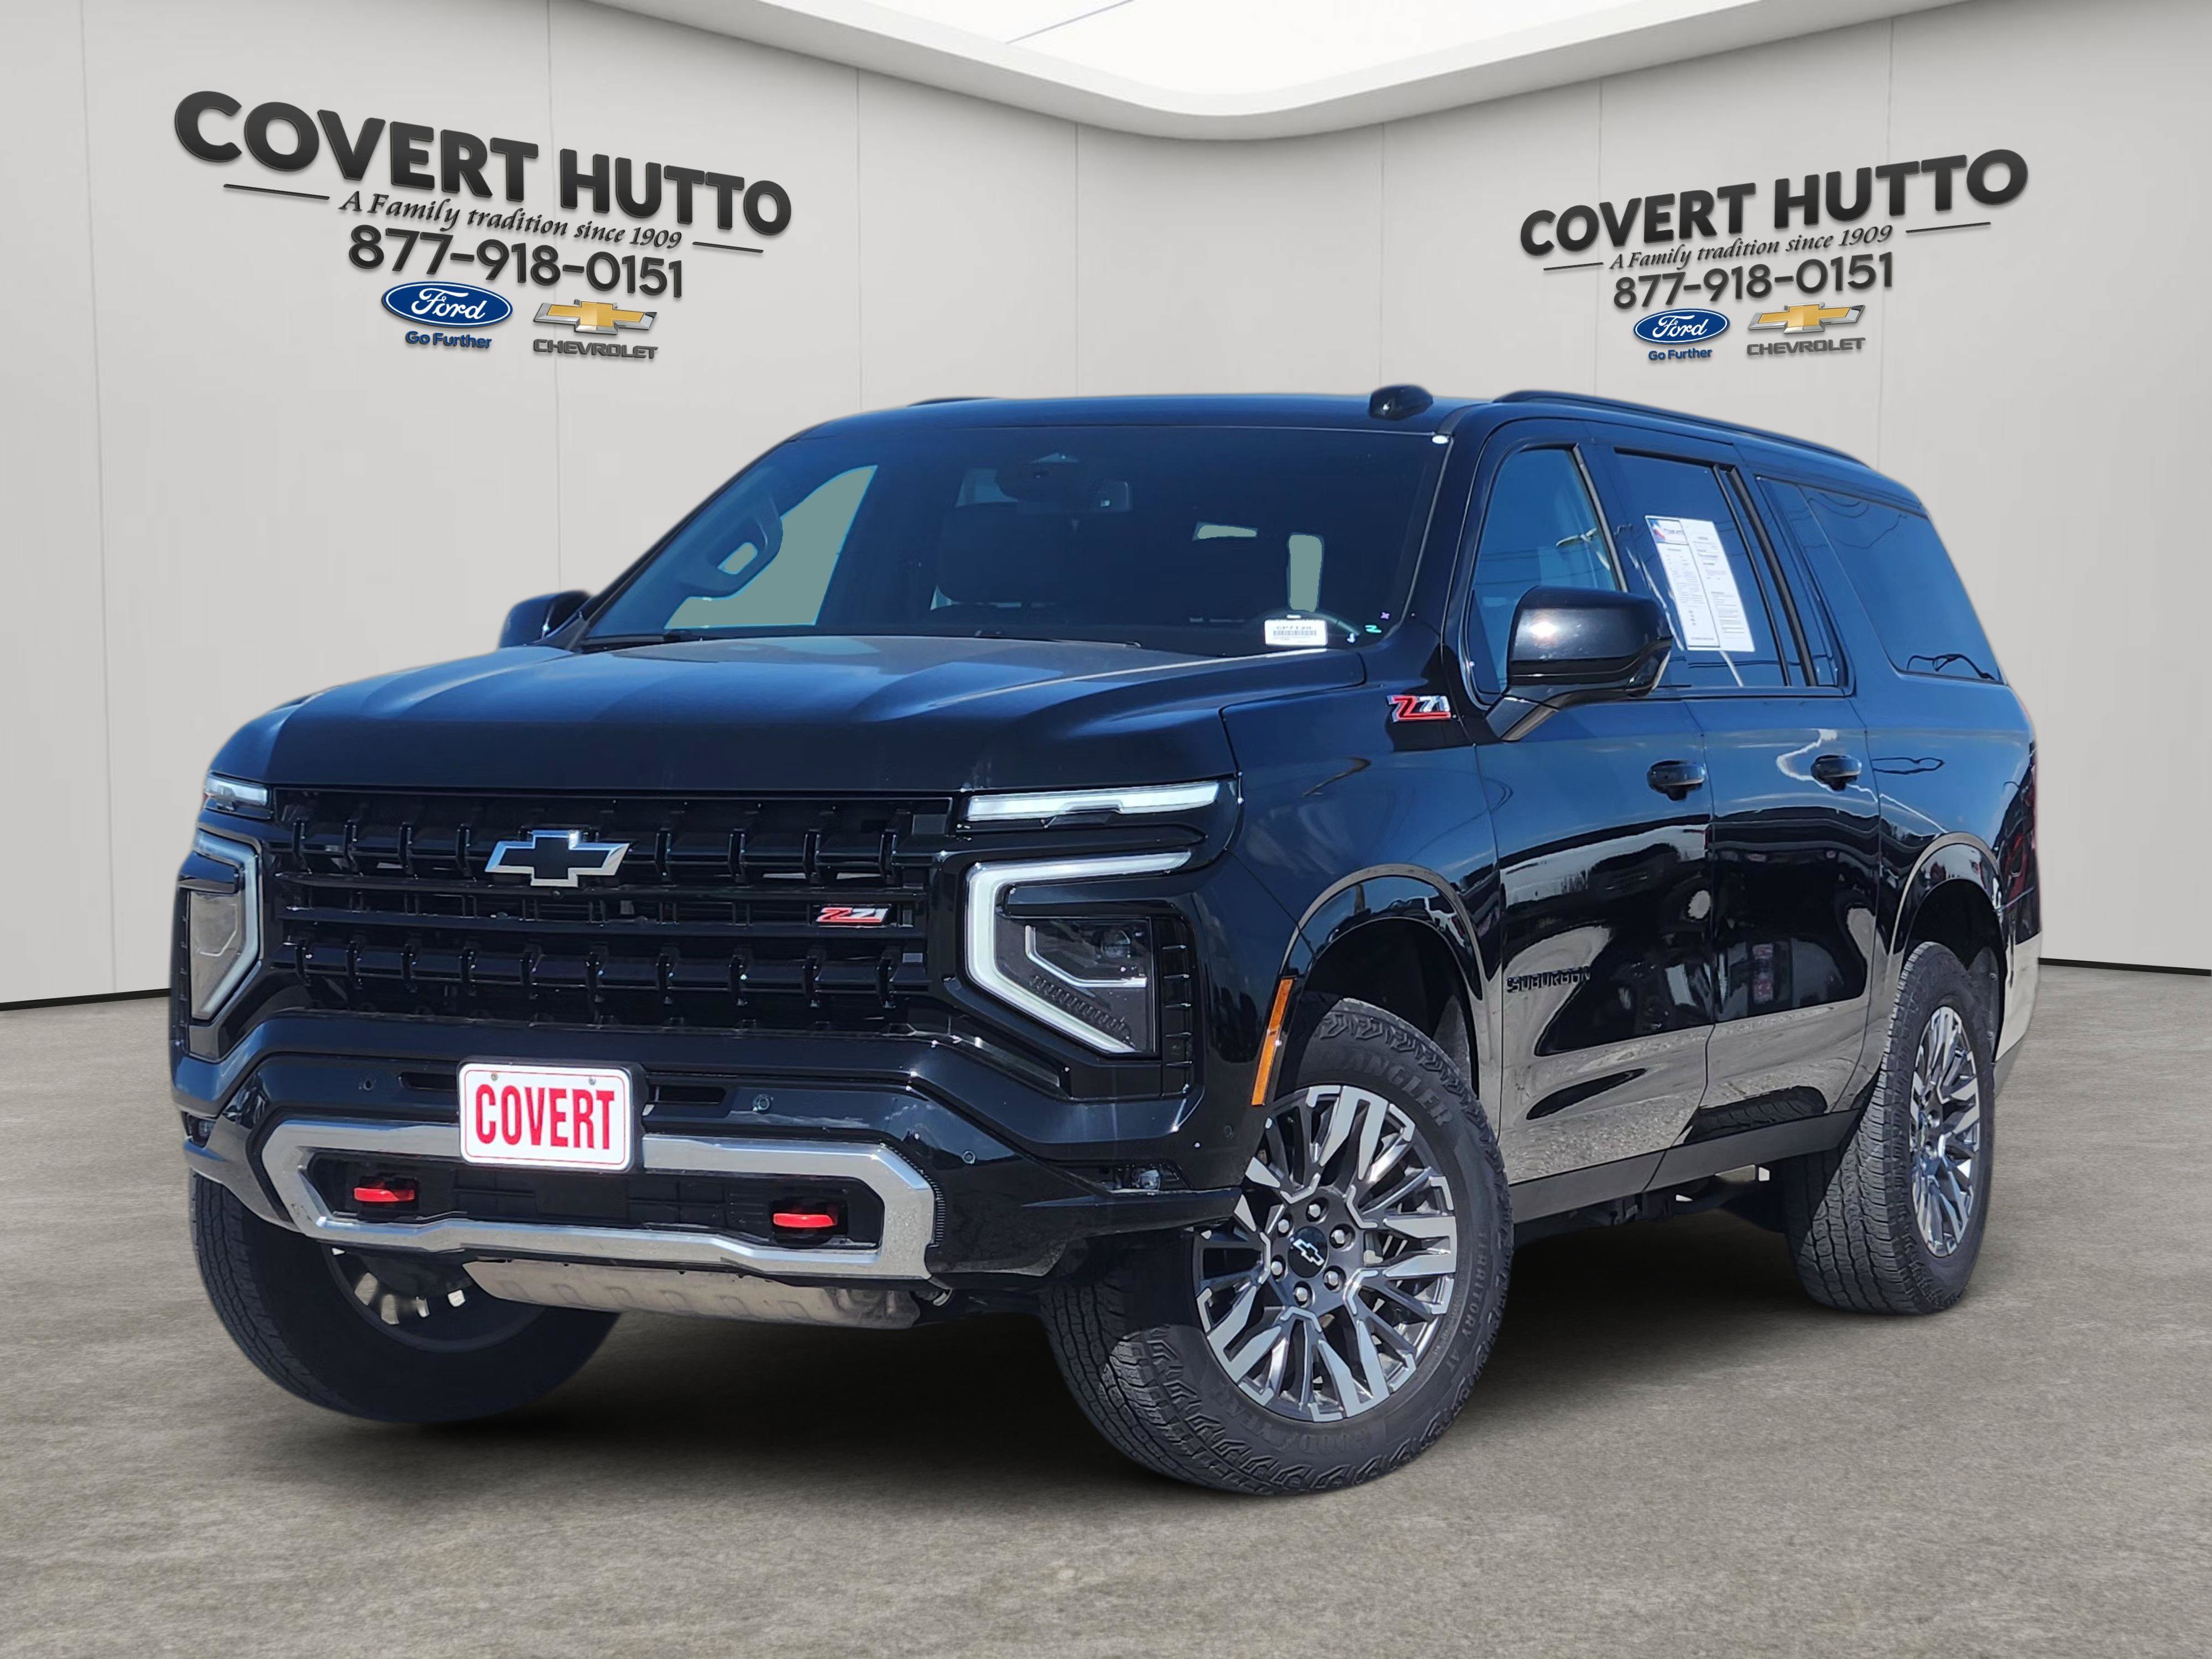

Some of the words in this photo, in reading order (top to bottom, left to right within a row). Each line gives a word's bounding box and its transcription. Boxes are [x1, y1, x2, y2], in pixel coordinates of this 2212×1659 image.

[174, 91, 538, 202] COVERT
[560, 148, 791, 236] HUTTO
[1520, 182, 1756, 256] COVERT
[1774, 149, 2028, 229] HUTTO
[338, 190, 363, 212] A
[367, 193, 461, 232] Family
[467, 207, 568, 236] tradition
[573, 220, 625, 243] since
[629, 227, 682, 249] 1909
[348, 224, 682, 298] 877-918-0151
[1609, 253, 1624, 270] A
[1627, 243, 1692, 270] Family
[1697, 237, 1780, 261] tradition
[1785, 234, 1834, 252] since
[1838, 225, 1893, 247] 1909
[1614, 251, 1892, 309] 877-918-0151
[411, 288, 488, 320] Ford
[405, 331, 430, 345] Go
[432, 332, 492, 348] Further
[1652, 315, 1709, 338] Ford
[533, 338, 659, 359] CHEVROLET
[1648, 350, 1666, 361] Go
[1667, 347, 1713, 359] Further
[1746, 337, 1866, 356] CHEVROLET
[1386, 694, 1452, 722] Z71
[1506, 966, 1591, 993] SUBURBAN
[476, 1083, 615, 1150] COVERT
